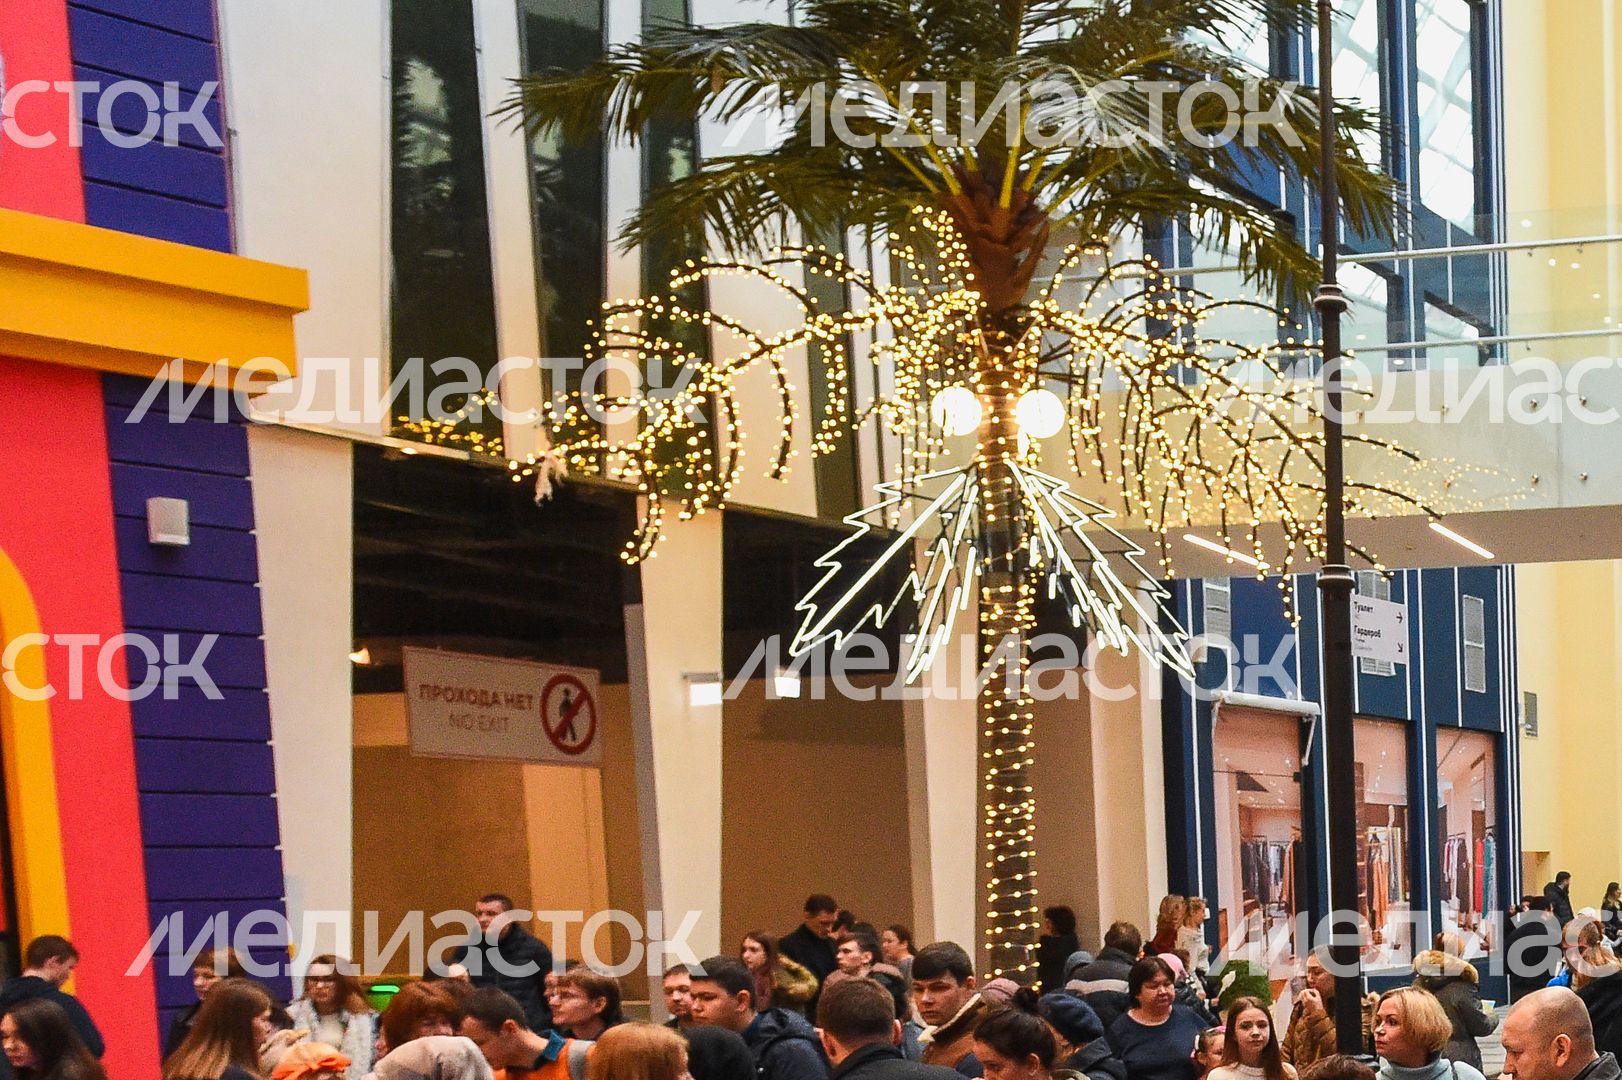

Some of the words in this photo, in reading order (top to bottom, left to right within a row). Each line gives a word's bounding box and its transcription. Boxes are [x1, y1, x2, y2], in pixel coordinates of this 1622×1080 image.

[419, 684, 499, 708] ПРОХОДА
[505, 693, 533, 711] НЕТ
[450, 714, 473, 730] NO
[479, 716, 510, 733] EXIT
